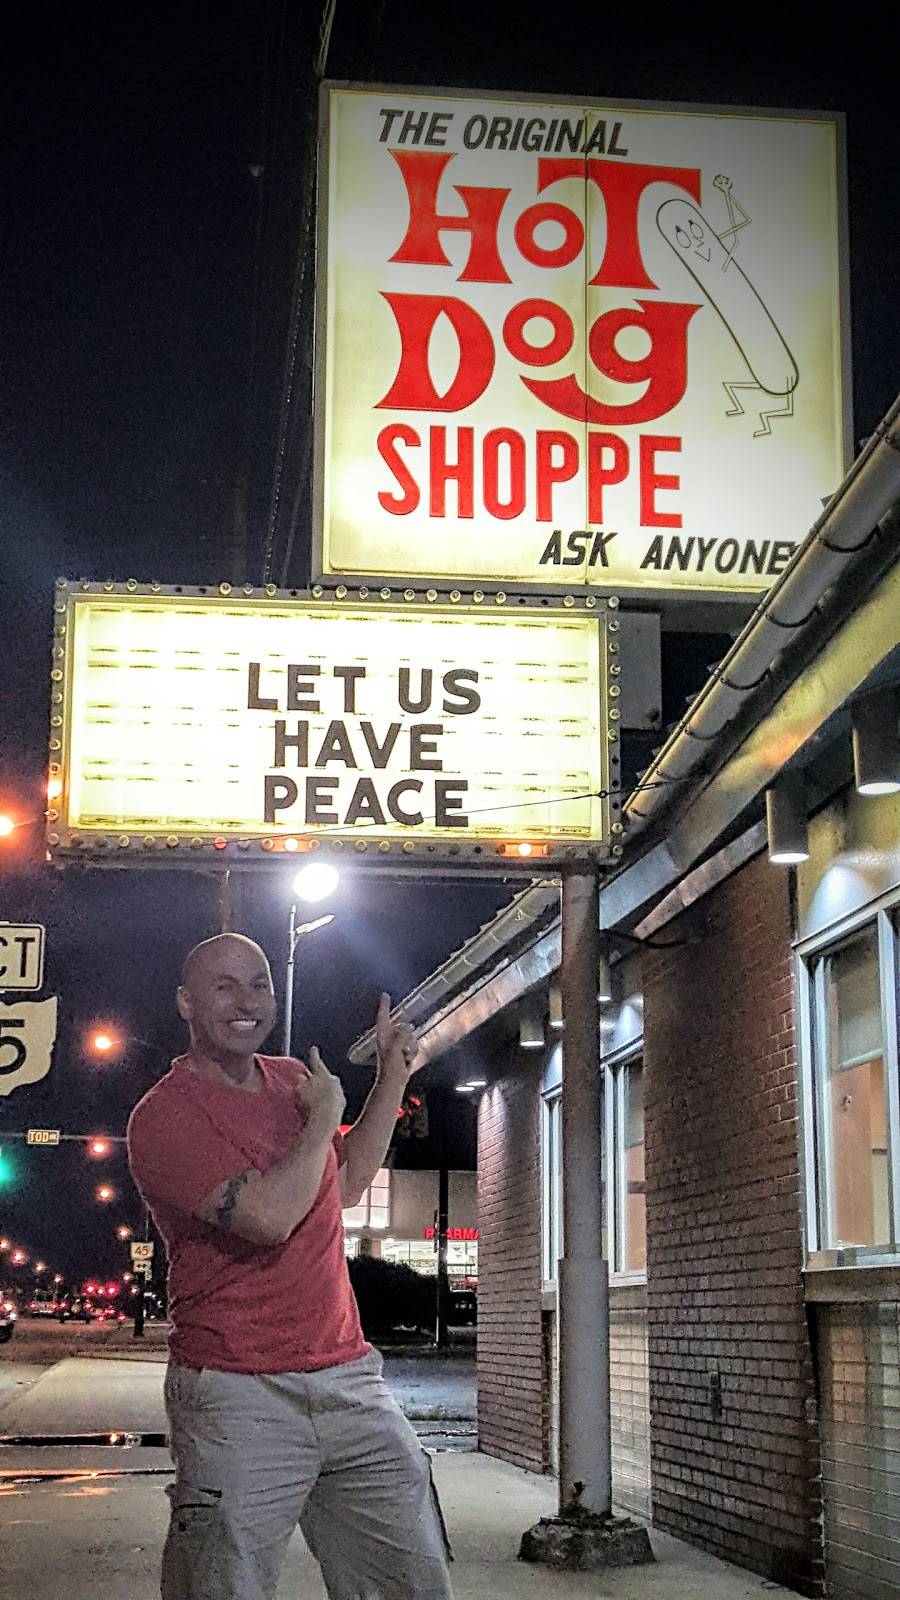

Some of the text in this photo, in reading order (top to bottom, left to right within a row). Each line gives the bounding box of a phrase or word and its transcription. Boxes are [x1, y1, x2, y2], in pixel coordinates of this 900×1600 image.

[378, 108, 629, 157] THE ORIGINAL
[377, 423, 683, 528] SHOPPE
[539, 530, 796, 575] ASK ANYONE
[247, 662, 481, 715] LET US
[274, 720, 444, 771] HAVE
[264, 775, 469, 828] PEACE
[134, 1245, 149, 1256] 45
[424, 1227, 479, 1240] PARM
